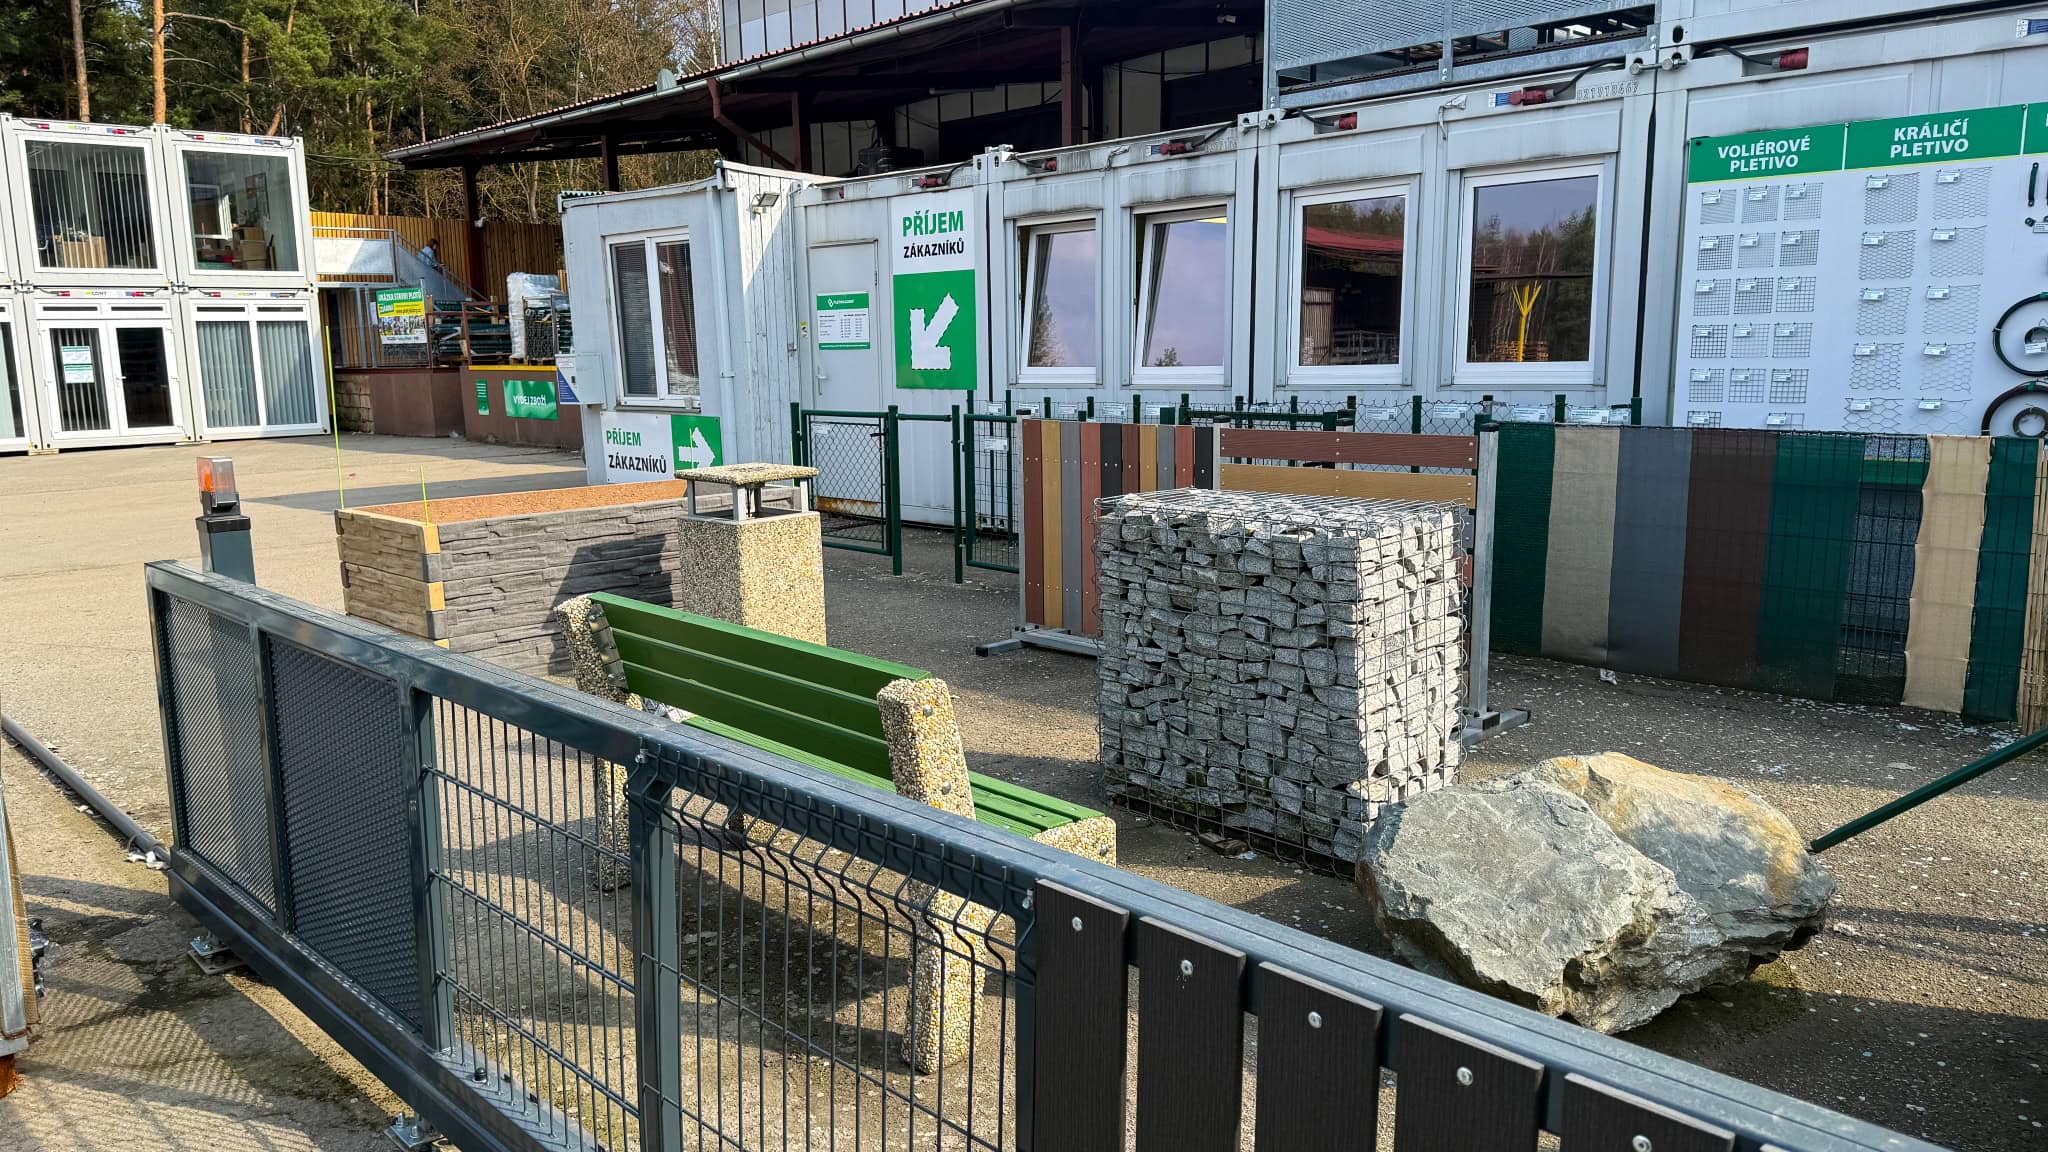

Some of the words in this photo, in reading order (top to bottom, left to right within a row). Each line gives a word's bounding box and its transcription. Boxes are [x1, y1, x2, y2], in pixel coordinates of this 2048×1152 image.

[1893, 118, 1970, 142] KRÁLIČÍ
[1718, 135, 1812, 160] VOLIÉROVÉ
[1890, 138, 1970, 159] PLETIVO
[1729, 154, 1800, 173] PLETIVO
[902, 209, 964, 237] PŘÍJEM
[903, 238, 965, 259] ZÁKAZNÍKŮ
[605, 428, 642, 447] PŘÍJEM
[608, 452, 667, 474] ZÁKAZNÍKŮ
